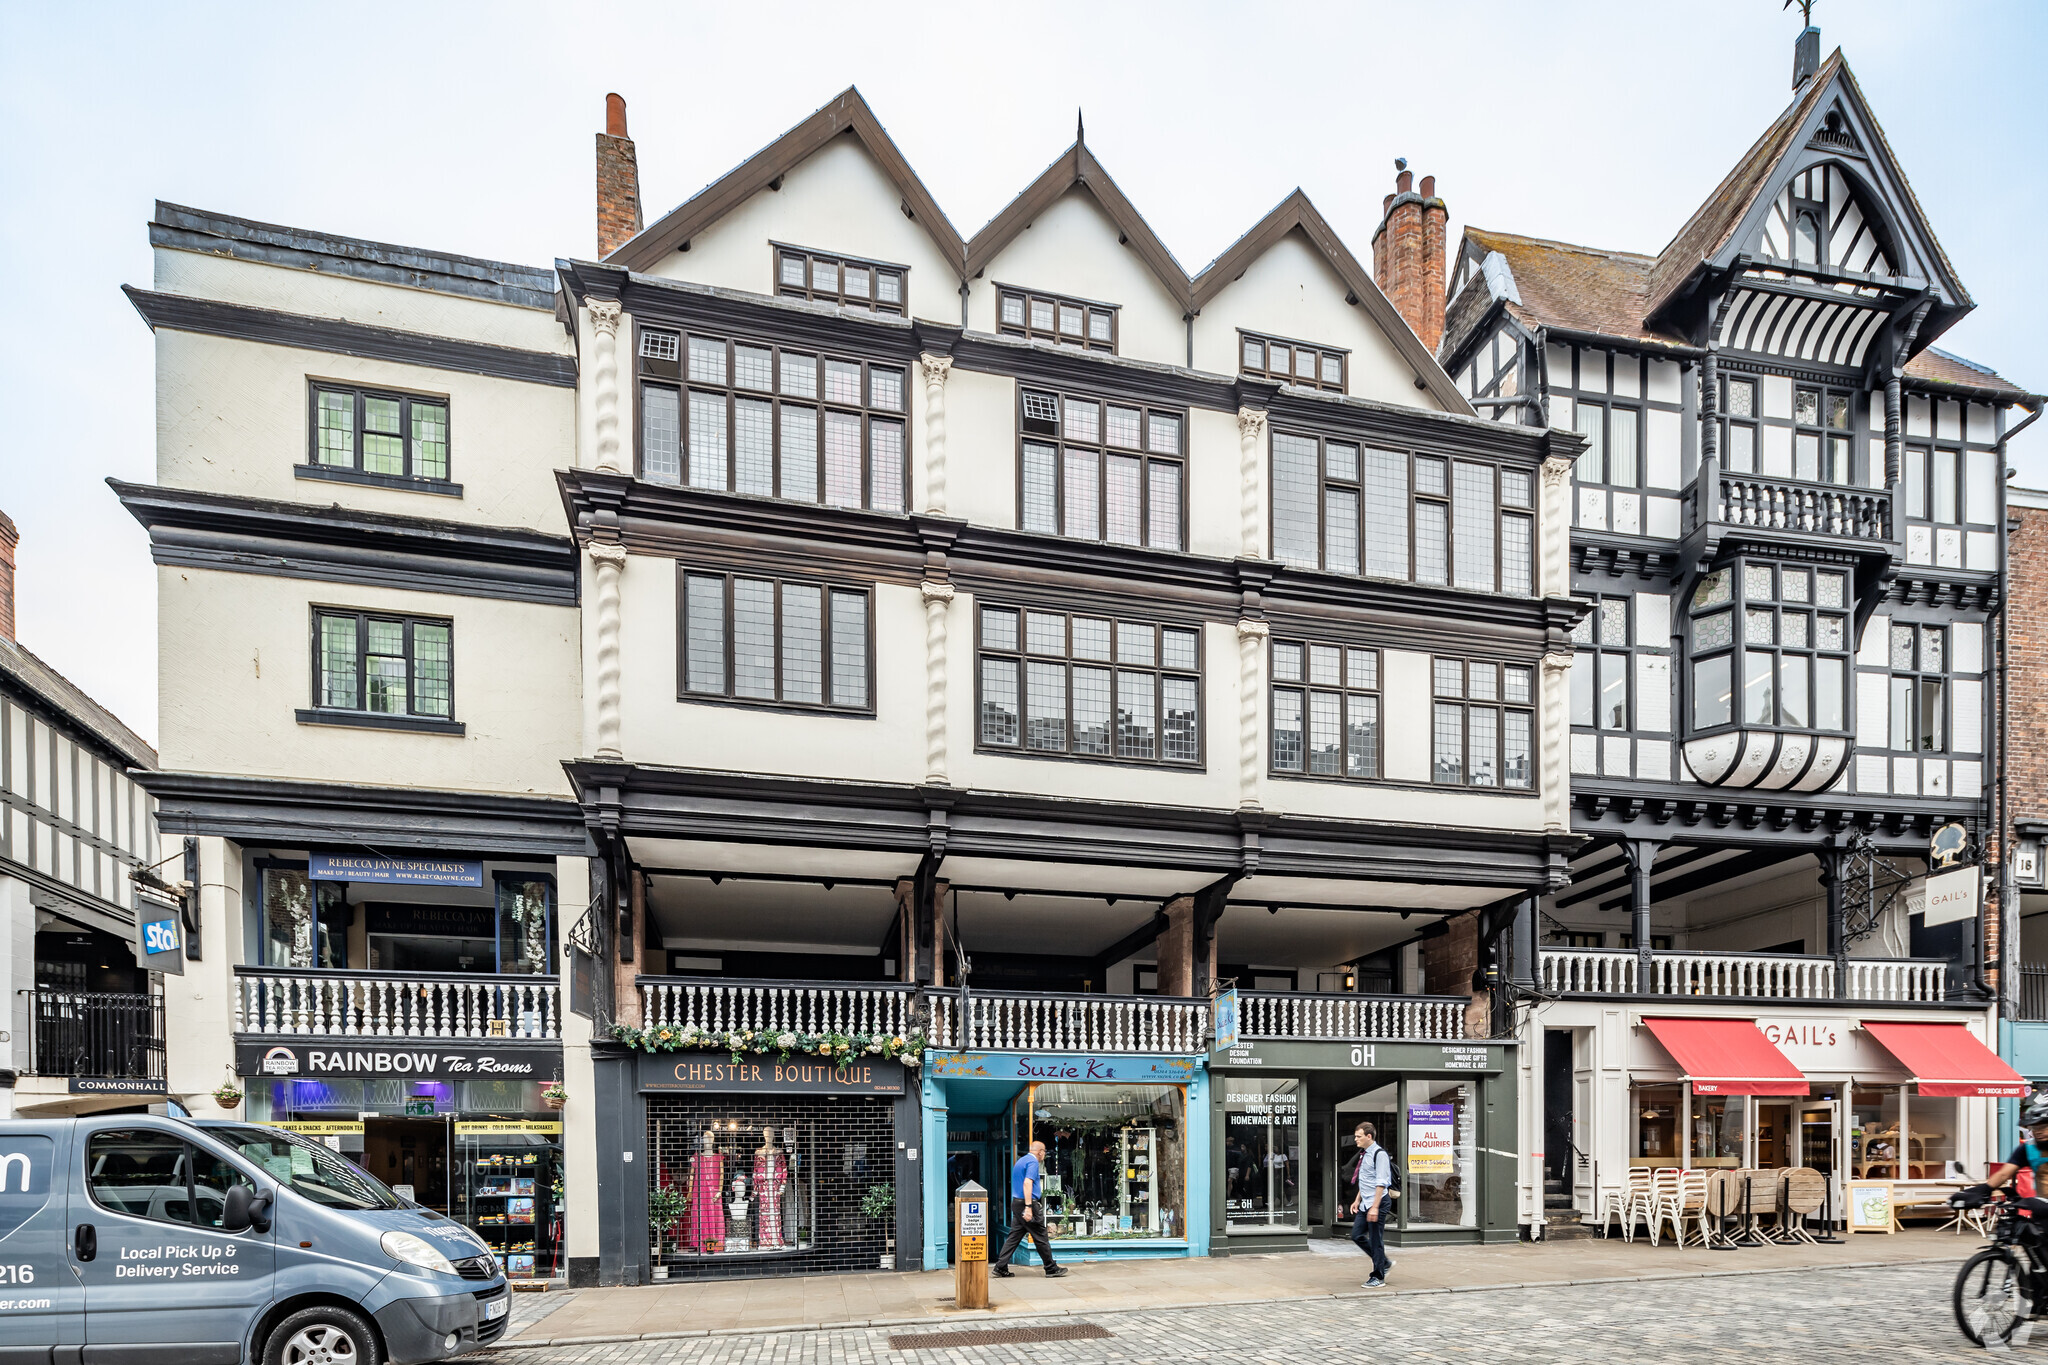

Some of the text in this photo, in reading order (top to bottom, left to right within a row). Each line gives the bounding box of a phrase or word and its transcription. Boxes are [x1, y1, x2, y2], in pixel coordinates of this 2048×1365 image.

[374, 860, 406, 870] JAYNE
[2020, 859, 2032, 870] 18
[1931, 890, 1967, 906] GAIL's
[1764, 1024, 1836, 1046] GAIL's
[1229, 1049, 1249, 1057] DESIGN
[309, 1051, 533, 1074] RAINBOW Tea Rooms
[1017, 1057, 1110, 1079] Suzie K
[674, 1063, 872, 1085] CHESTER BOUTIQUE
[78, 1081, 166, 1091] COMMONHALL
[1226, 1093, 1297, 1103] DESIGNER FASHION
[1245, 1105, 1297, 1115] UNIQUE GIFTS
[1231, 1115, 1297, 1125] HOMEWARE & ART
[1424, 1132, 1438, 1140] ALL
[1411, 1140, 1451, 1149] ENQUIRIES
[120, 1245, 237, 1260] Local Pick Up &
[115, 1262, 239, 1279] Delivery Service
